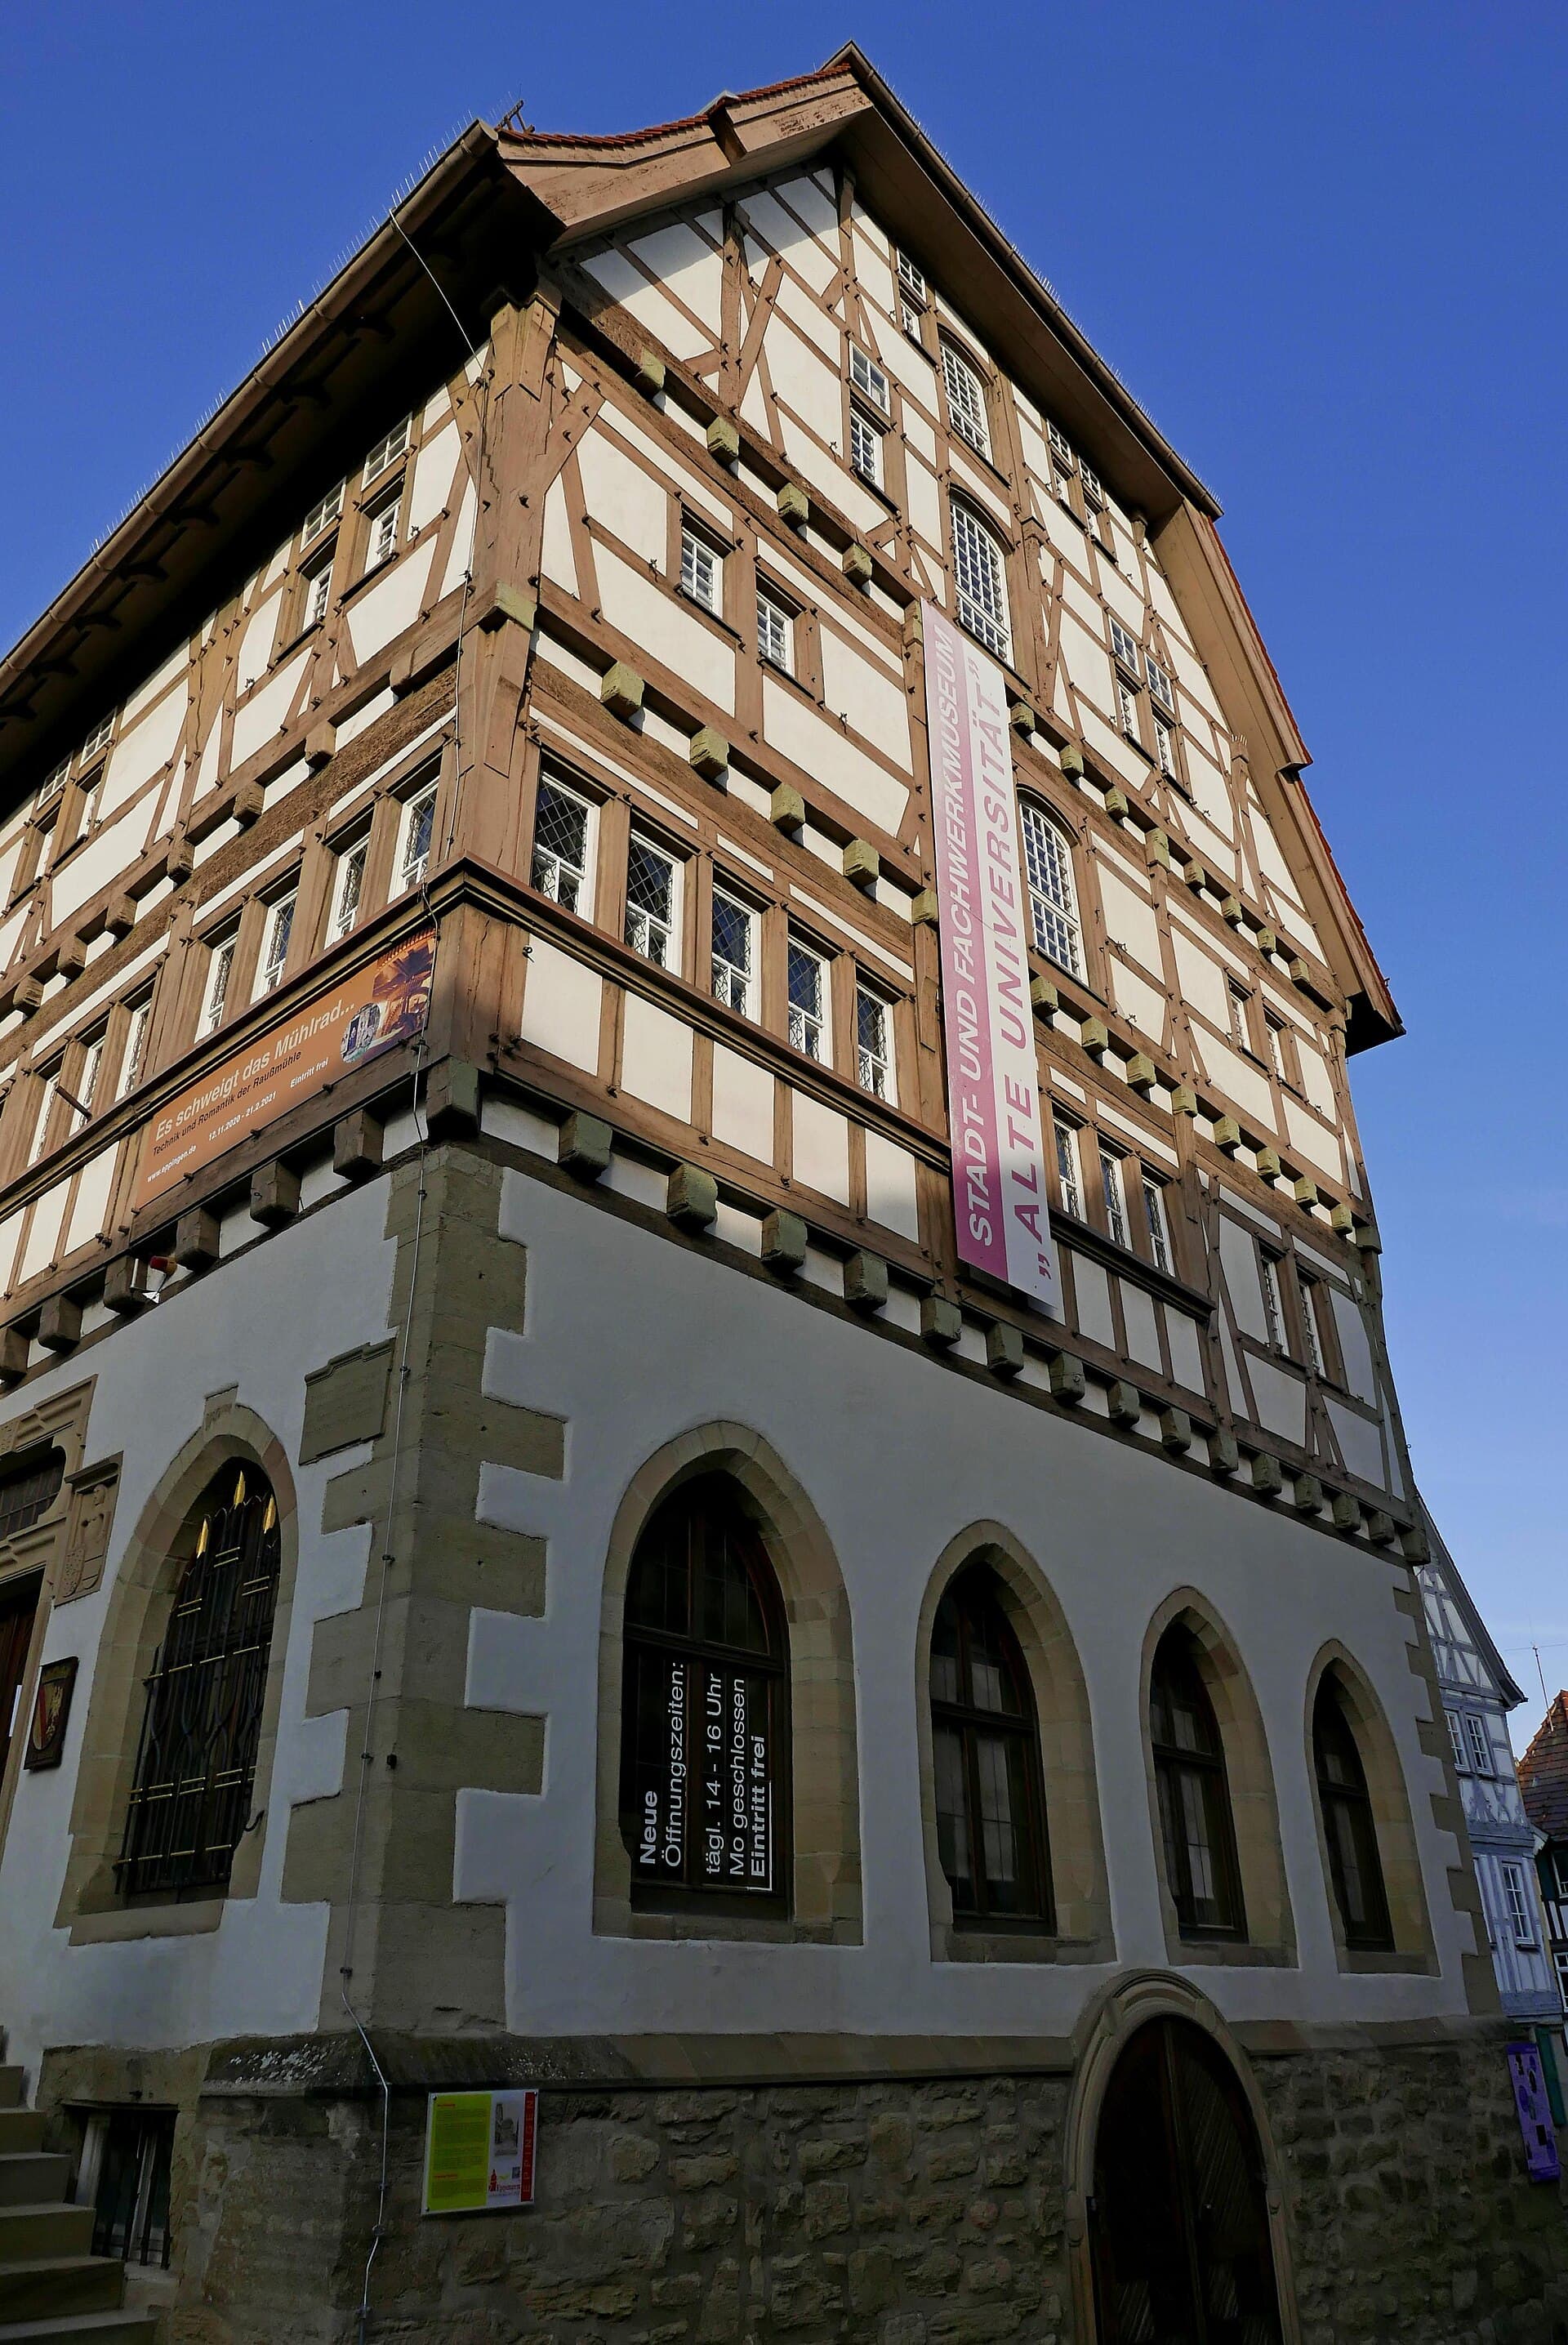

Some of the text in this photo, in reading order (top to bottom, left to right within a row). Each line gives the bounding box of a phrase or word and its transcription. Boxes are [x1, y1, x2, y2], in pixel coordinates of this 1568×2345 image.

[933, 625, 992, 1247] STADT- UND FACHWERKMUSEUM
[153, 1051, 301, 1157] Technik und Romantik der Raußmühle
[155, 999, 354, 1142] Es schweigt das Mühlrad...
[290, 1056, 329, 1088] Eintritt frei
[208, 1114, 242, 1140] 12.11.2020
[245, 1090, 277, 1117] 21.2.2021
[706, 1673, 722, 1716] Uhr
[662, 1661, 687, 1867] Öffnungszeiten:
[706, 1725, 721, 1753] 16
[729, 1679, 748, 1875] Mo geschlossen
[639, 1790, 657, 1864] Neue
[706, 1781, 721, 1809] 14
[751, 1736, 765, 1877] Eintritt frei
[706, 1821, 724, 1875] tägl.
[522, 2099, 535, 2192] EPPINGEN
